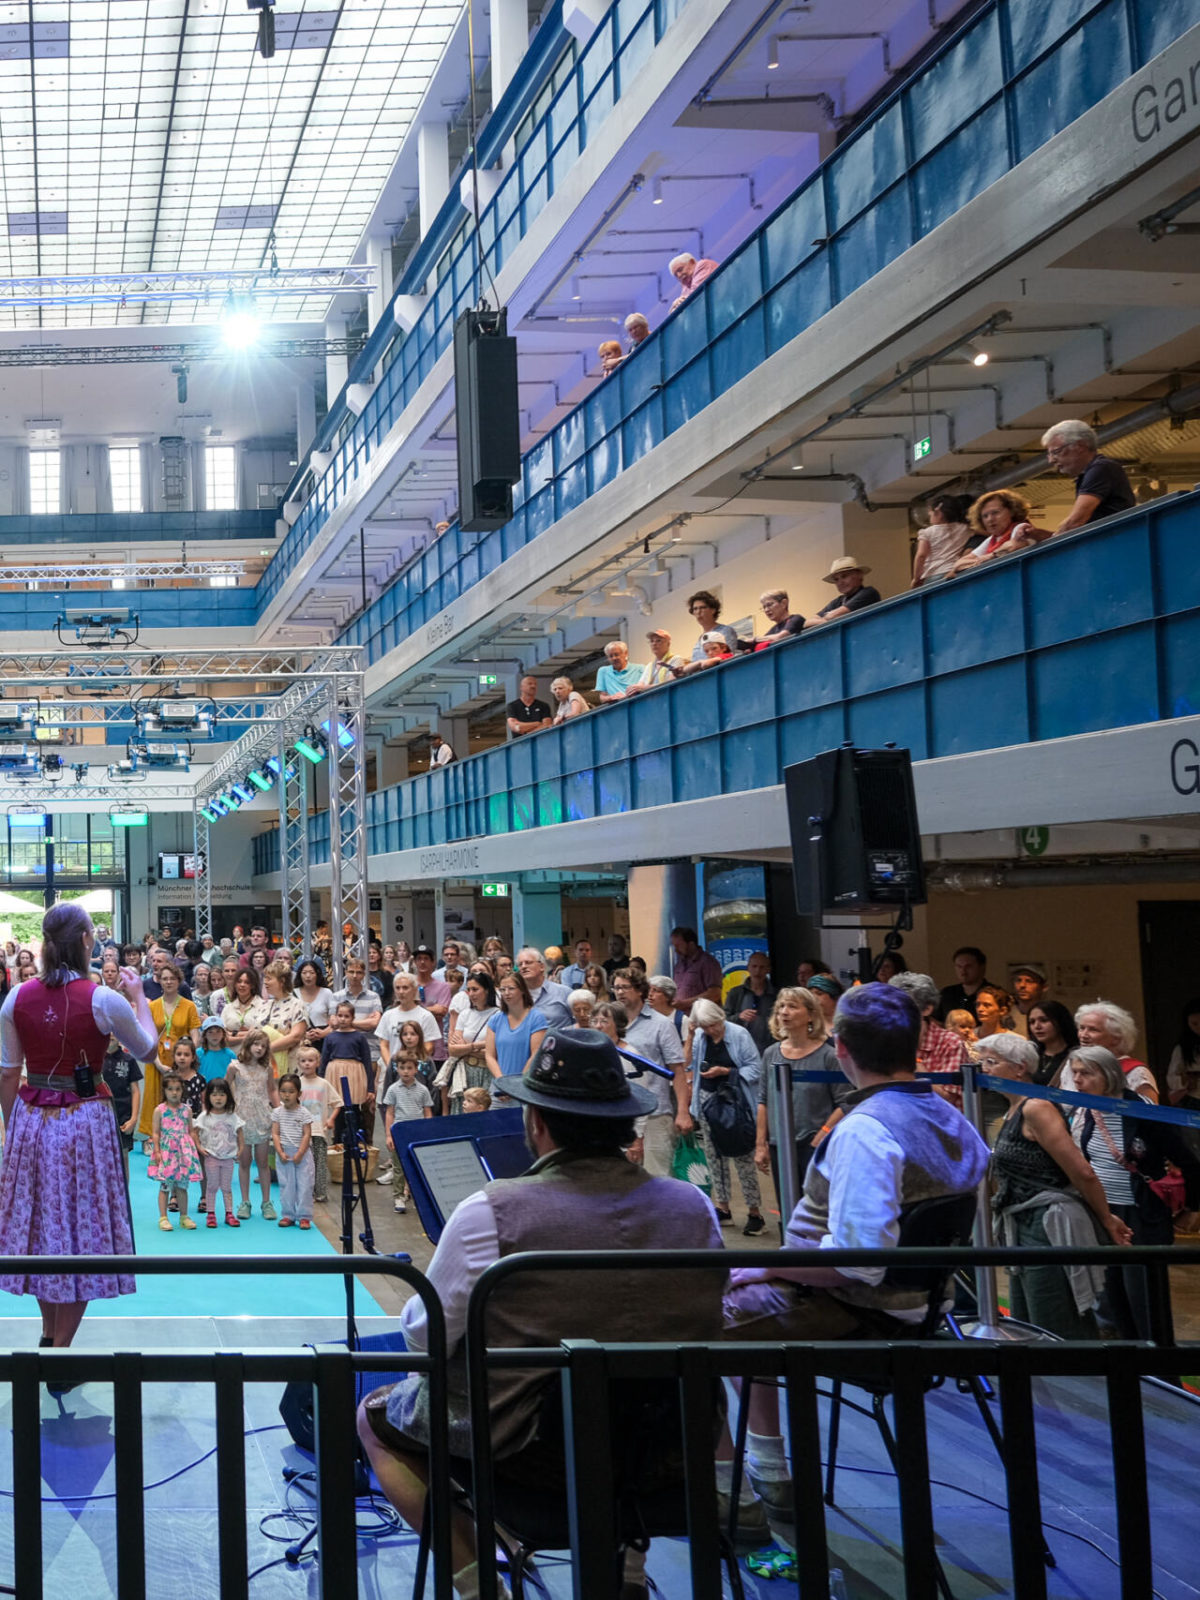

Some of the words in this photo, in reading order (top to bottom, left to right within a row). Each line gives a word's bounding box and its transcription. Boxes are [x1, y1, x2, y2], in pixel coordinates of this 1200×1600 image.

[443, 614, 455, 635] Bar
[1170, 738, 1200, 795] G
[1025, 827, 1042, 849] 4
[420, 843, 480, 873] ISARPHILHARMONIE
[158, 884, 192, 892] Münchner
